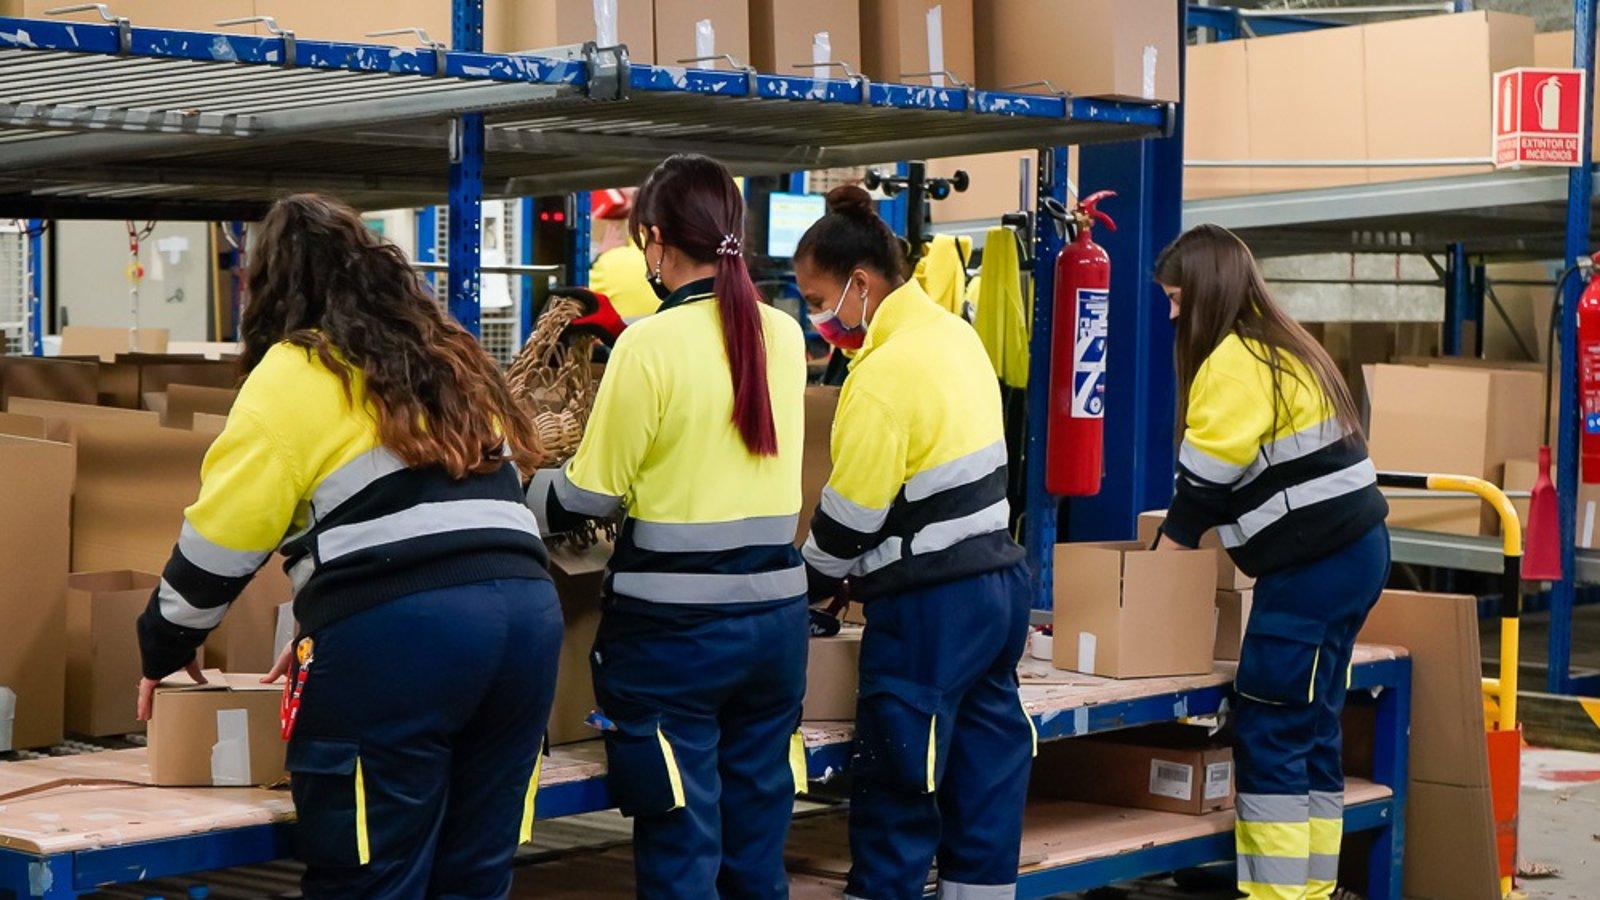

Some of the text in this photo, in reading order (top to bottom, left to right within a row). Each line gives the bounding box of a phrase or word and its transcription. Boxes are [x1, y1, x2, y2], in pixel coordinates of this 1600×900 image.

[1521, 138, 1563, 149] EXTINTOR
[1566, 139, 1577, 149] DE
[1526, 150, 1572, 160] INCENDIOS
